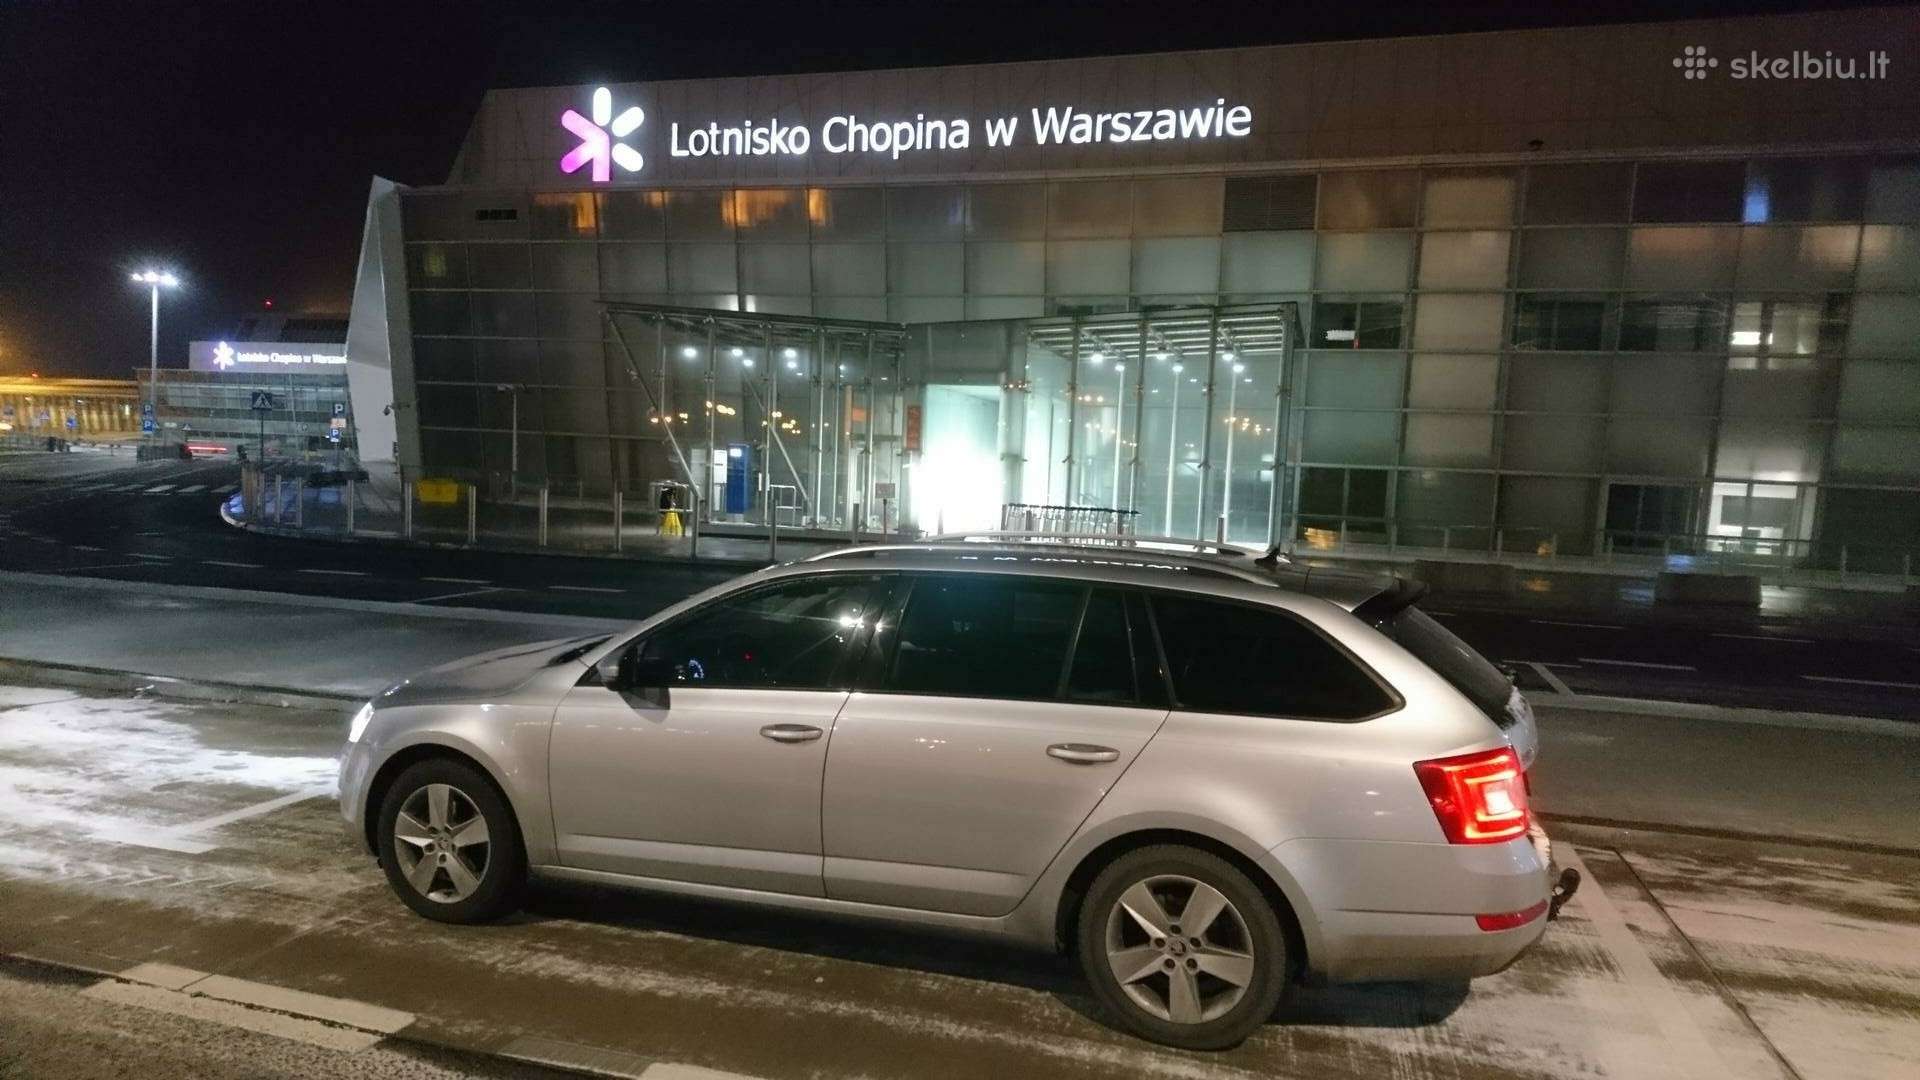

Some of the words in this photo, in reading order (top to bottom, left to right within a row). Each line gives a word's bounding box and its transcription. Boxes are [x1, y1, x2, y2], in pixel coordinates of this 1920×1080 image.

[671, 118, 811, 158] Lotnisko
[823, 114, 970, 160] Chopina
[985, 116, 1019, 147] w
[1032, 98, 1252, 145] Warszawie
[334, 403, 344, 414] P
